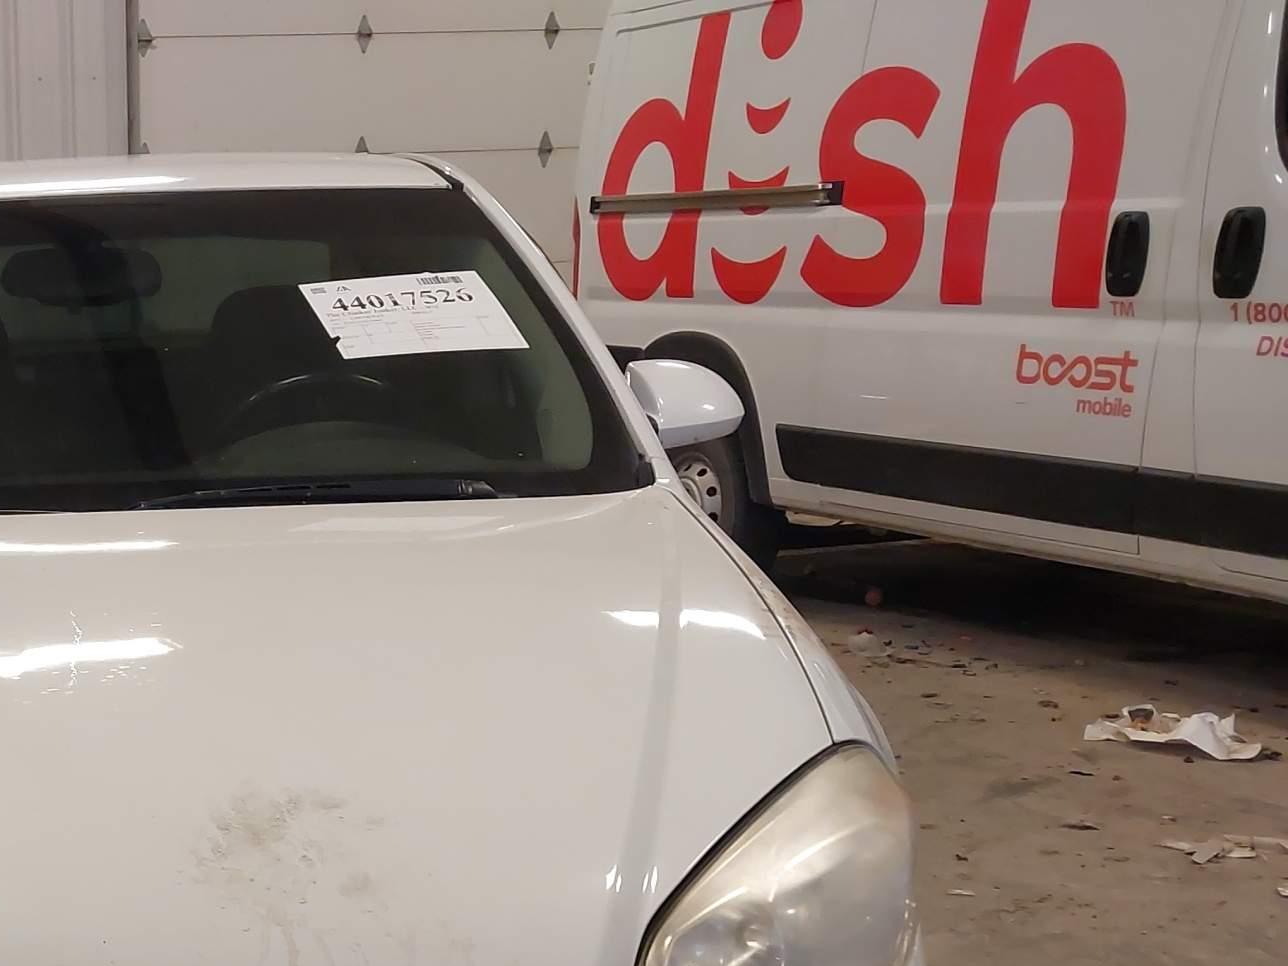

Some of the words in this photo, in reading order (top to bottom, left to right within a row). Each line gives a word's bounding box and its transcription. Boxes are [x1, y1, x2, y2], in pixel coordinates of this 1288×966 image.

[597, 0, 1126, 308] dish
[332, 288, 474, 311] 44017526
[1110, 301, 1135, 317] TM
[1230, 302, 1238, 321] 1
[1016, 344, 1139, 393] boost
[1076, 397, 1132, 418] mobile
